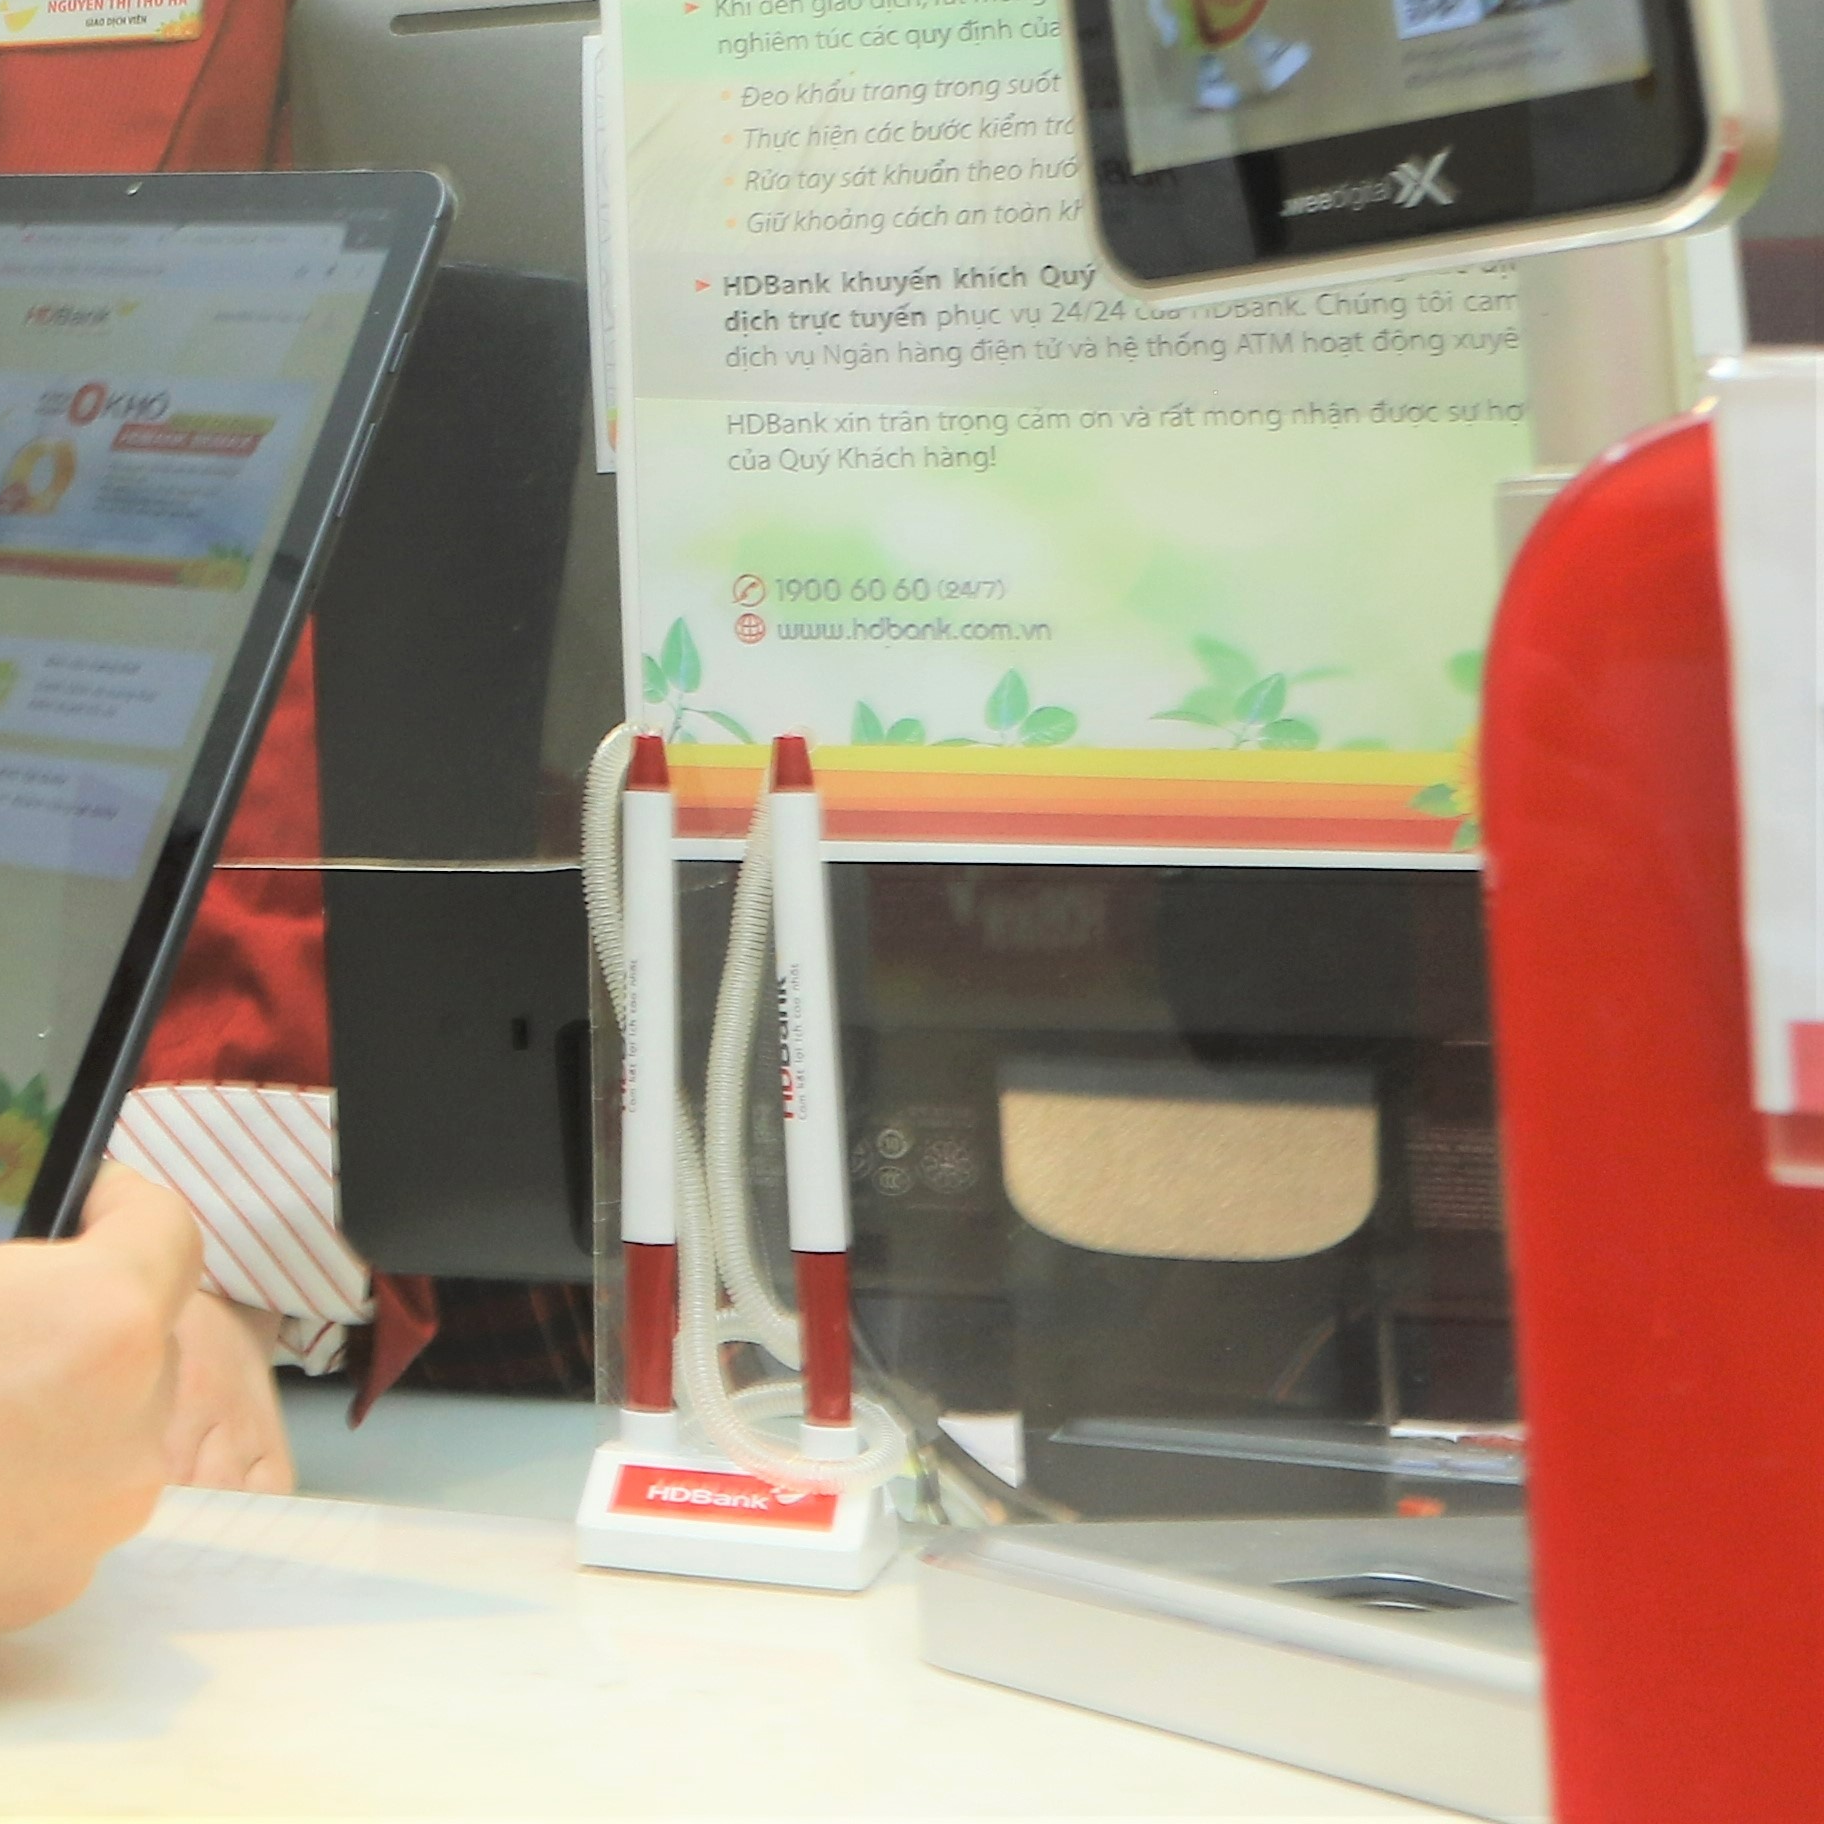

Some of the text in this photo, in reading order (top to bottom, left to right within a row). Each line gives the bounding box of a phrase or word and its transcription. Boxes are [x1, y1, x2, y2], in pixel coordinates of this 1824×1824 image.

[85, 18, 105, 27] GIAO
[719, 30, 808, 58] nghiêm
[816, 27, 854, 49] túc
[860, 24, 899, 47] các
[908, 23, 951, 50] quy
[958, 16, 1013, 45] định
[740, 69, 1061, 109] Đeo khẩu trang trong suốt
[747, 209, 790, 234] Giữ
[795, 205, 886, 234] khoảng
[893, 202, 948, 228] cách
[957, 204, 986, 225] an
[993, 200, 1051, 224] toàn
[723, 264, 1096, 297] HDBank khuyến khích Quý
[725, 309, 778, 339] dịch
[789, 310, 841, 336] trực
[851, 302, 927, 331] tuyến
[937, 304, 1000, 332] phục
[1011, 305, 1042, 325] vụ
[1052, 300, 1125, 322] 24/24
[1316, 290, 1406, 319] Chúng
[1419, 289, 1453, 313] tôi
[726, 325, 1519, 370] dịch vụ Ngân hàng điện tử và hệ thống ATM hoạt động xuyê
[727, 398, 1526, 437] HDBank xin trân trọng cảm ơn và rất mong nhận được sự hợ
[729, 444, 996, 474] của Quý Khách hàng!
[775, 578, 1006, 602] 1900 60 60 (24/7)
[778, 617, 1052, 642] www.hdbank.com.vn
[646, 1484, 769, 1510] HDBank
